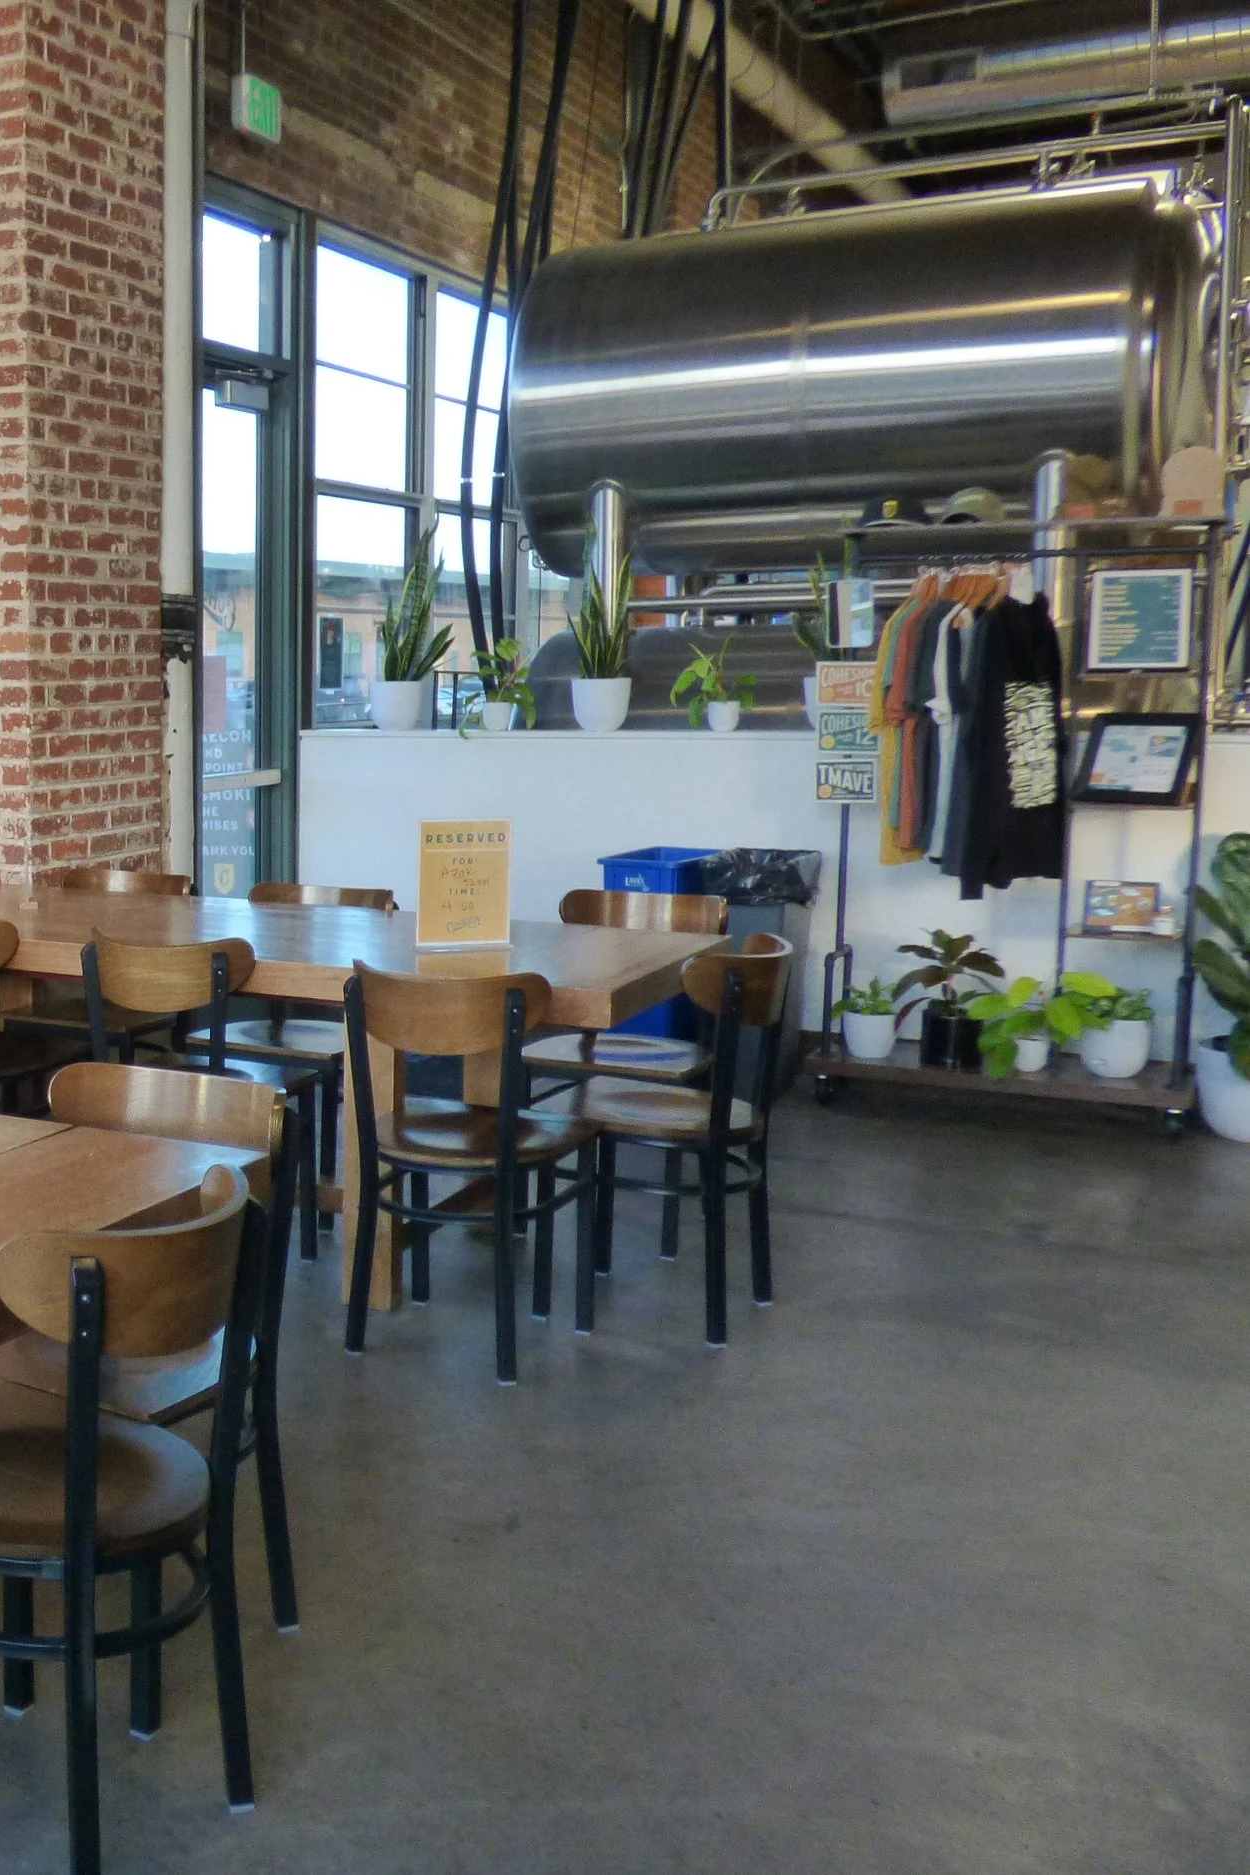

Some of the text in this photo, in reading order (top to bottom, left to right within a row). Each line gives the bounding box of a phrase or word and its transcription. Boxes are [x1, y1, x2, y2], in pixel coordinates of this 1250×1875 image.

[250, 82, 278, 136] EXIT
[205, 762, 244, 773] POINT
[426, 833, 506, 844] RESERVED
